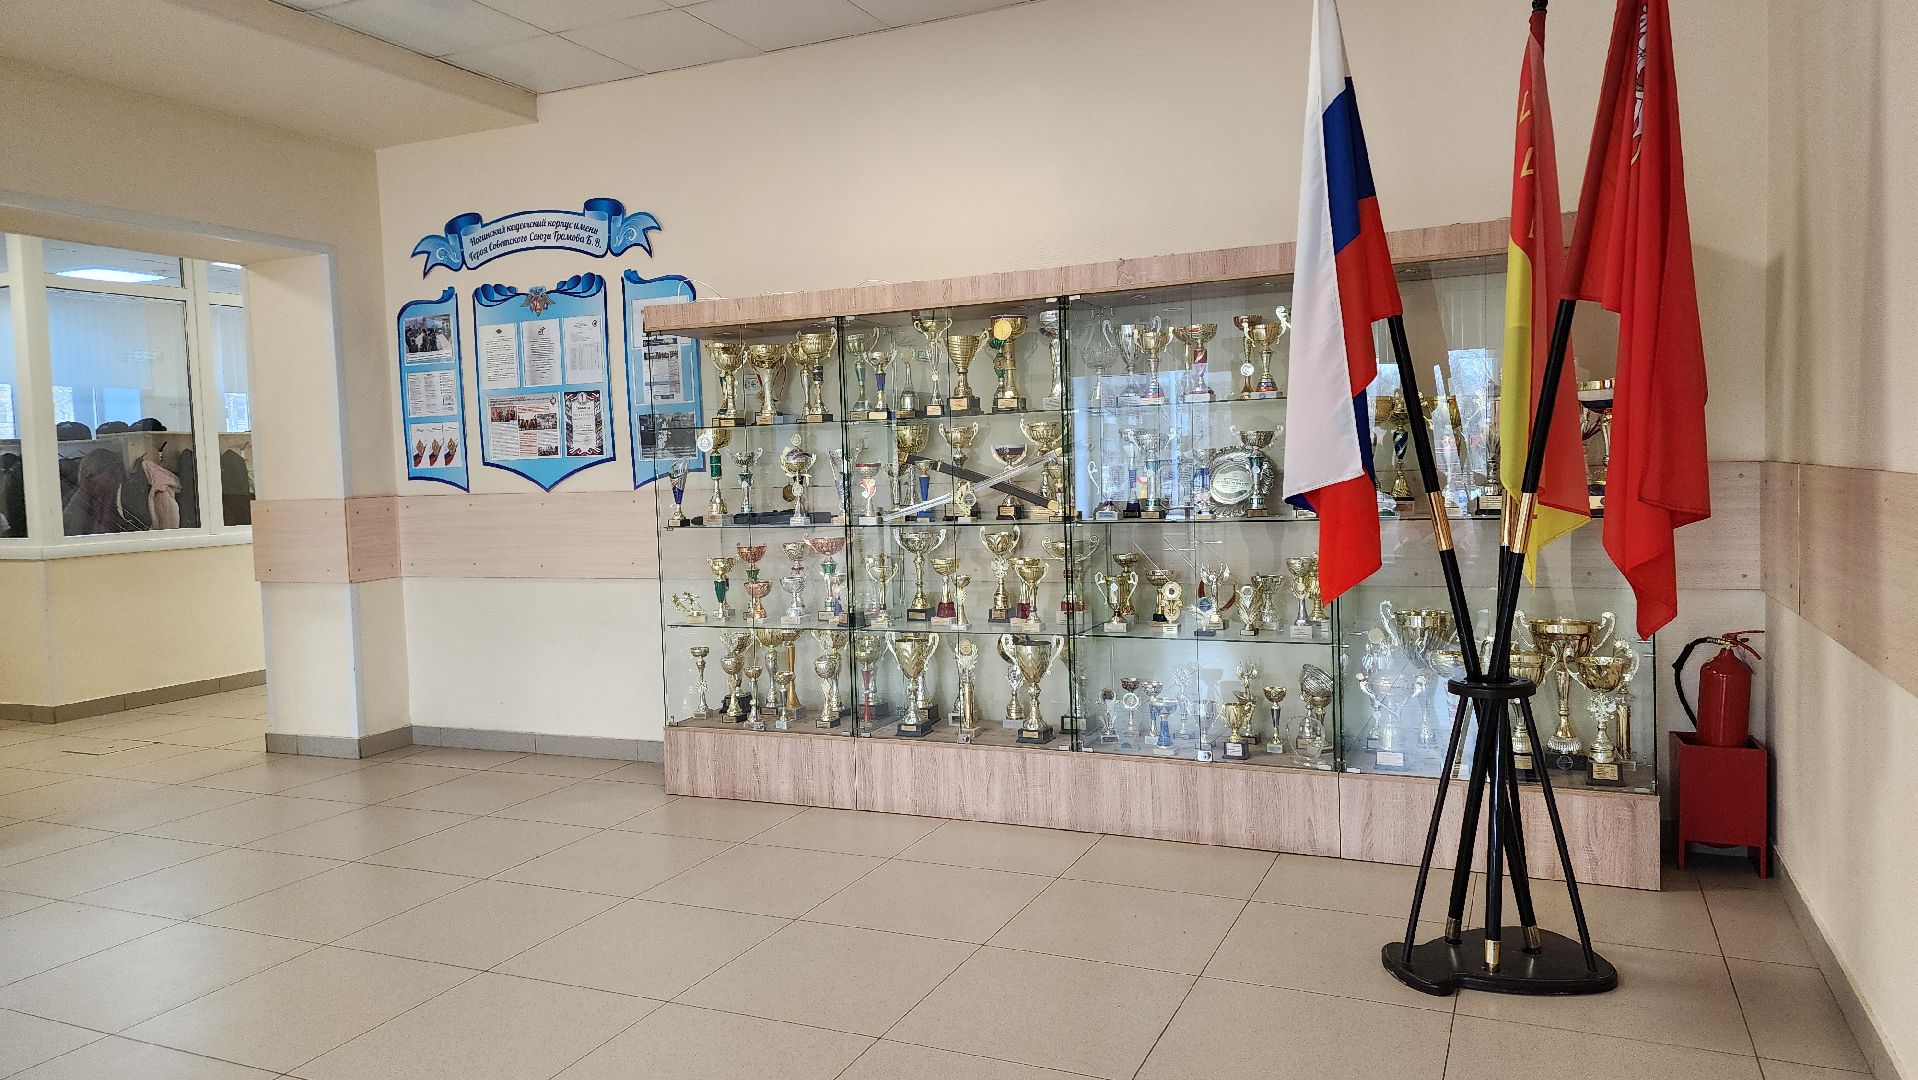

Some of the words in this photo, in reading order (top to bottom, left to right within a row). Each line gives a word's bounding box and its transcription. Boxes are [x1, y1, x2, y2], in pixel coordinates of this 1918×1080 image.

[548, 221, 573, 230] корпус
[574, 222, 598, 235] имени
[469, 246, 488, 261] Героя
[530, 231, 551, 243] Союза
[553, 230, 584, 243] Громова
